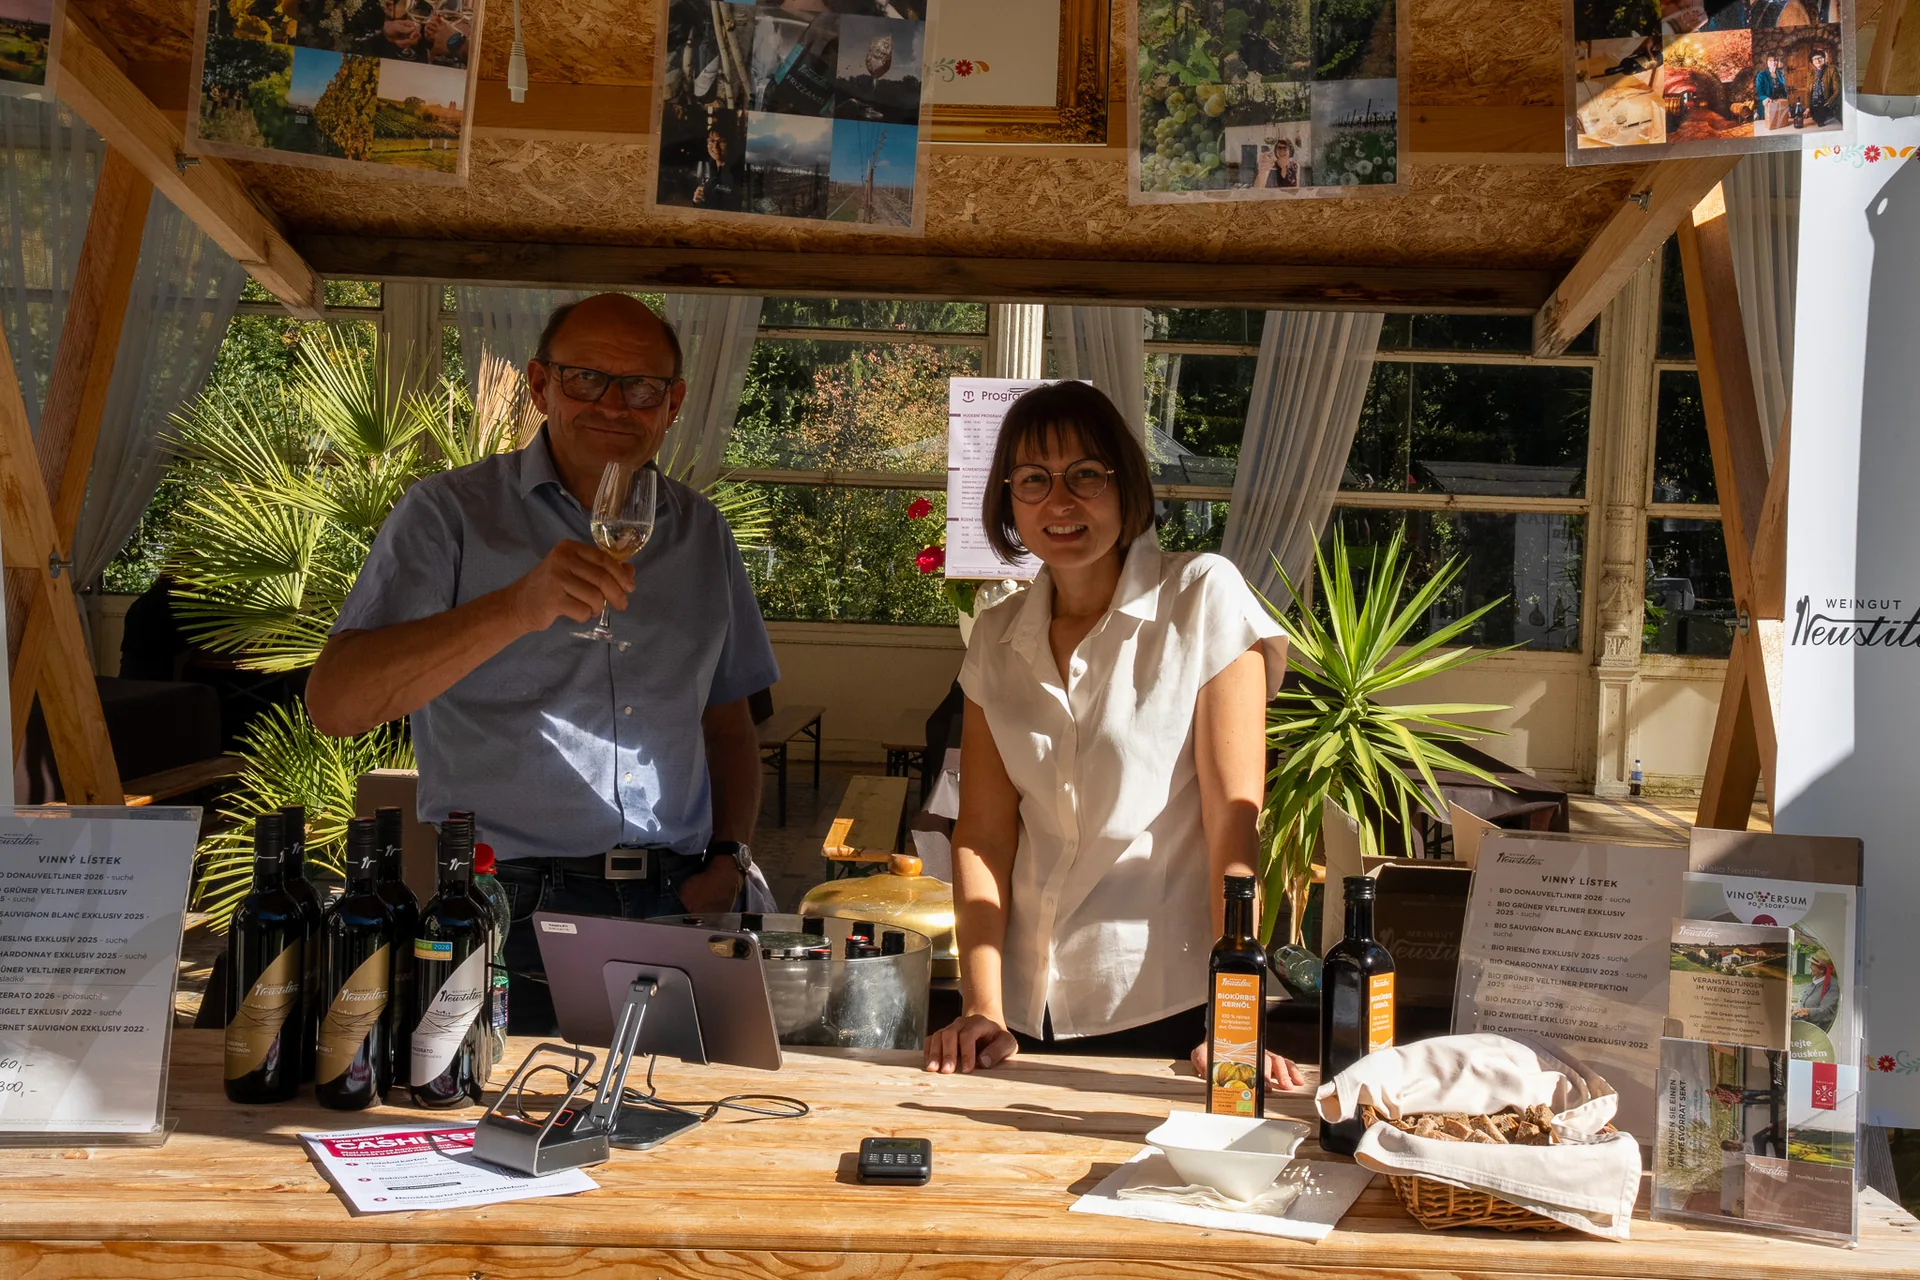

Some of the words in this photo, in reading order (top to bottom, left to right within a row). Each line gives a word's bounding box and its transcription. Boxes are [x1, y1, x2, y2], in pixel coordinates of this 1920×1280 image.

[1826, 599, 1902, 610] WEINGUT
[0, 833, 43, 846] eustifter
[38, 854, 77, 864] VINNÝ
[80, 855, 122, 865] LÍSTEK
[6, 872, 82, 880] DONAUVELTLINER
[1541, 875, 1576, 885] VINNÝ
[1579, 877, 1618, 888] LÍSTEK
[3, 885, 38, 894] GRÜNER
[41, 887, 85, 895] VELTLINER
[87, 888, 128, 896] EXKLUSIV
[12, 895, 36, 903] suché
[1514, 889, 1582, 900] DONAUVELTLINER
[1609, 896, 1631, 904] suché
[1512, 900, 1543, 911] GRÜNER
[1545, 905, 1586, 914] VELTLINER
[1587, 908, 1626, 917] EXKLUSIV
[81, 912, 122, 920] EXKLUSIV
[1520, 910, 1542, 919] suché
[1493, 922, 1508, 930] BIO
[1509, 923, 1555, 934] SAUVIGNON
[1556, 927, 1582, 936] BLANC
[1583, 930, 1622, 940] EXKLUSIV
[1623, 934, 1643, 942] 2025
[1493, 930, 1513, 938] suché
[77, 936, 98, 944] 2025
[124, 952, 147, 960] suché
[1506, 945, 1541, 955] RIESLING
[1542, 949, 1580, 959] EXKLUSIV
[1607, 955, 1629, 963] suché
[1, 965, 24, 974] ÜNER
[73, 967, 126, 975] PERFEKTION
[1489, 957, 1503, 965] BIO
[1504, 959, 1559, 971] CHARDONNAY
[1560, 965, 1599, 975] EXKLUSIV
[1600, 968, 1619, 977] 2025
[1626, 971, 1648, 980] suché
[1487, 972, 1502, 980] BIO
[1503, 972, 1534, 983] GRÜNER
[1536, 977, 1577, 987] VELTLINER
[1579, 981, 1629, 992] PERFEKTION
[1487, 980, 1505, 988] 2025
[1692, 976, 1765, 989] VERANSTALTUNGEN
[0, 991, 32, 999] ZERATO
[1706, 986, 1741, 994] WEINGUT
[1742, 988, 1760, 996] 2026
[1217, 993, 1256, 1002] BIOKÜRBIS
[1222, 1001, 1251, 1009] KERNÖL
[1500, 996, 1543, 1008] MAZERATO
[1544, 1001, 1564, 1009] 2026
[1570, 1004, 1608, 1014] polosuché
[28, 1008, 69, 1016] EXKLUSIV
[99, 1009, 122, 1017] suché
[1483, 1009, 1497, 1017] BIO
[1498, 1011, 1538, 1022] ZWEIGELT
[1539, 1015, 1578, 1026] EXKLUSIV
[1578, 1020, 1598, 1029] 2022
[1604, 1022, 1628, 1031] suché
[80, 1025, 122, 1033] EXKLUSIV
[1482, 1024, 1496, 1032] BIO
[1588, 1036, 1627, 1047] EXKLUSIV
[1628, 1041, 1648, 1049] 2022
[1791, 1039, 1812, 1048] tejte
[1791, 1049, 1827, 1059] ouském
[1669, 1079, 1677, 1104] EINEN
[1679, 1080, 1687, 1102] SEKT
[1678, 1104, 1687, 1169] JAHRESVORRAT
[1667, 1122, 1676, 1168] GEWINNEN
[1815, 1176, 1840, 1184] Neustifter
